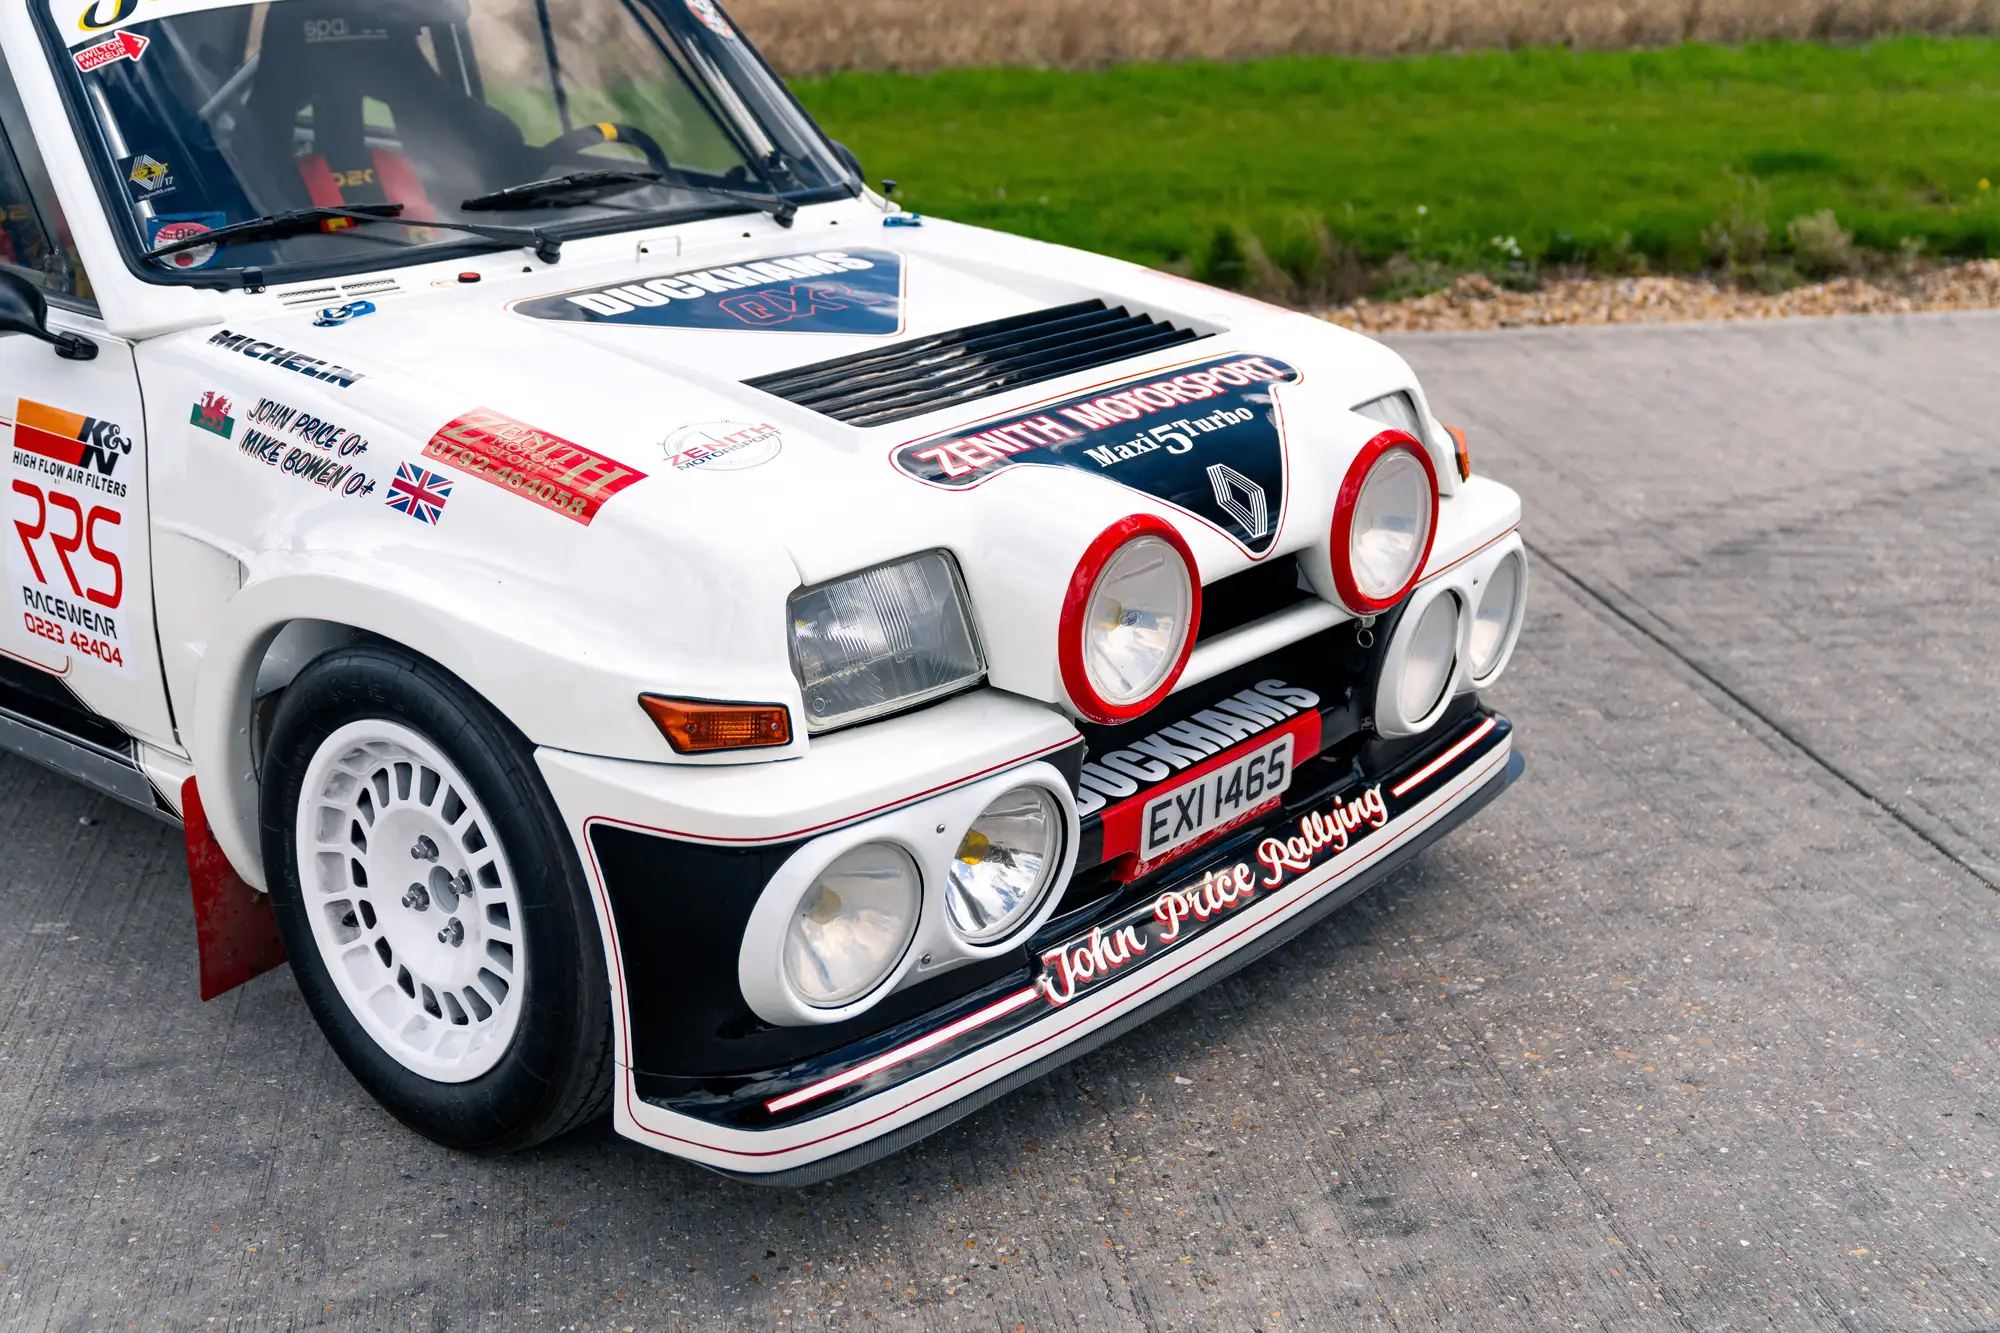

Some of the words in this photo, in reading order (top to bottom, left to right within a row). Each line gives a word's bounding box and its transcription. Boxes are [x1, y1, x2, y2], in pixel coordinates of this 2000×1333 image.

[82, 47, 127, 69] WAKEUP
[164, 175, 174, 186] 17
[565, 251, 875, 317] DUCKHAMS
[206, 329, 367, 389] MICHELIN
[247, 397, 297, 431] JOHN
[288, 412, 346, 450] PRICE
[663, 422, 776, 467] ZENITH
[916, 415, 1080, 480] ZENITH
[1061, 356, 1290, 431] MOTORSPORT
[12, 450, 36, 470] HIGH
[38, 458, 65, 478] FLOW
[66, 466, 84, 485] AIR
[85, 473, 127, 498] FILTERS
[239, 427, 287, 466] MIKE
[280, 446, 352, 491] BOWEN
[440, 413, 634, 497] ZENITH
[484, 445, 546, 473] SPORT
[491, 436, 557, 470] MOTOR
[676, 429, 782, 471] MOTORSPORT
[1082, 434, 1158, 468] Maxi
[429, 439, 588, 517] 0792-464058
[12, 479, 123, 609] RRS
[22, 585, 118, 639] RACEWEAR
[24, 612, 65, 645] 0223
[69, 631, 123, 667] 42404
[1149, 783, 1205, 850] EXI
[1215, 742, 1287, 819] 1465
[1043, 926, 1148, 1007] John
[1153, 862, 1256, 944] Price
[1257, 783, 1389, 889] Rallying
